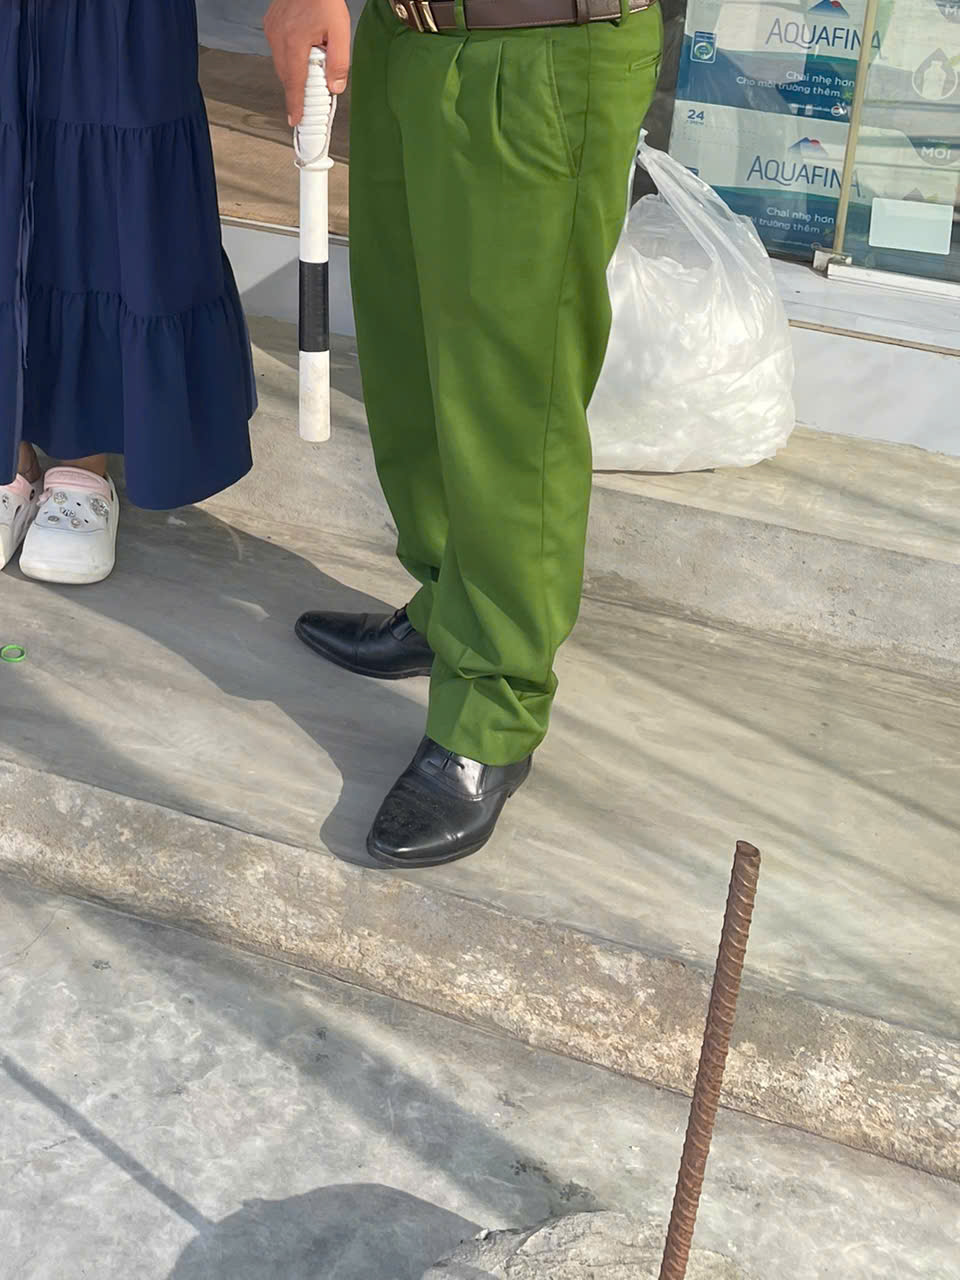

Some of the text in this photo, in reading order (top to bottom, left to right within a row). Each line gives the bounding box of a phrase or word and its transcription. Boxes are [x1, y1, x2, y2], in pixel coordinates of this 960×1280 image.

[764, 17, 881, 51] AQUAFINA
[736, 76, 755, 86] Cho
[778, 81, 811, 95] trường
[812, 85, 841, 98] thêm
[785, 70, 855, 88] Chai nhẹ hơn
[687, 109, 705, 121] 24
[746, 155, 861, 198] AQUAFINA
[766, 206, 835, 225] Chai nhẹ hơn
[792, 222, 821, 234] thêm
